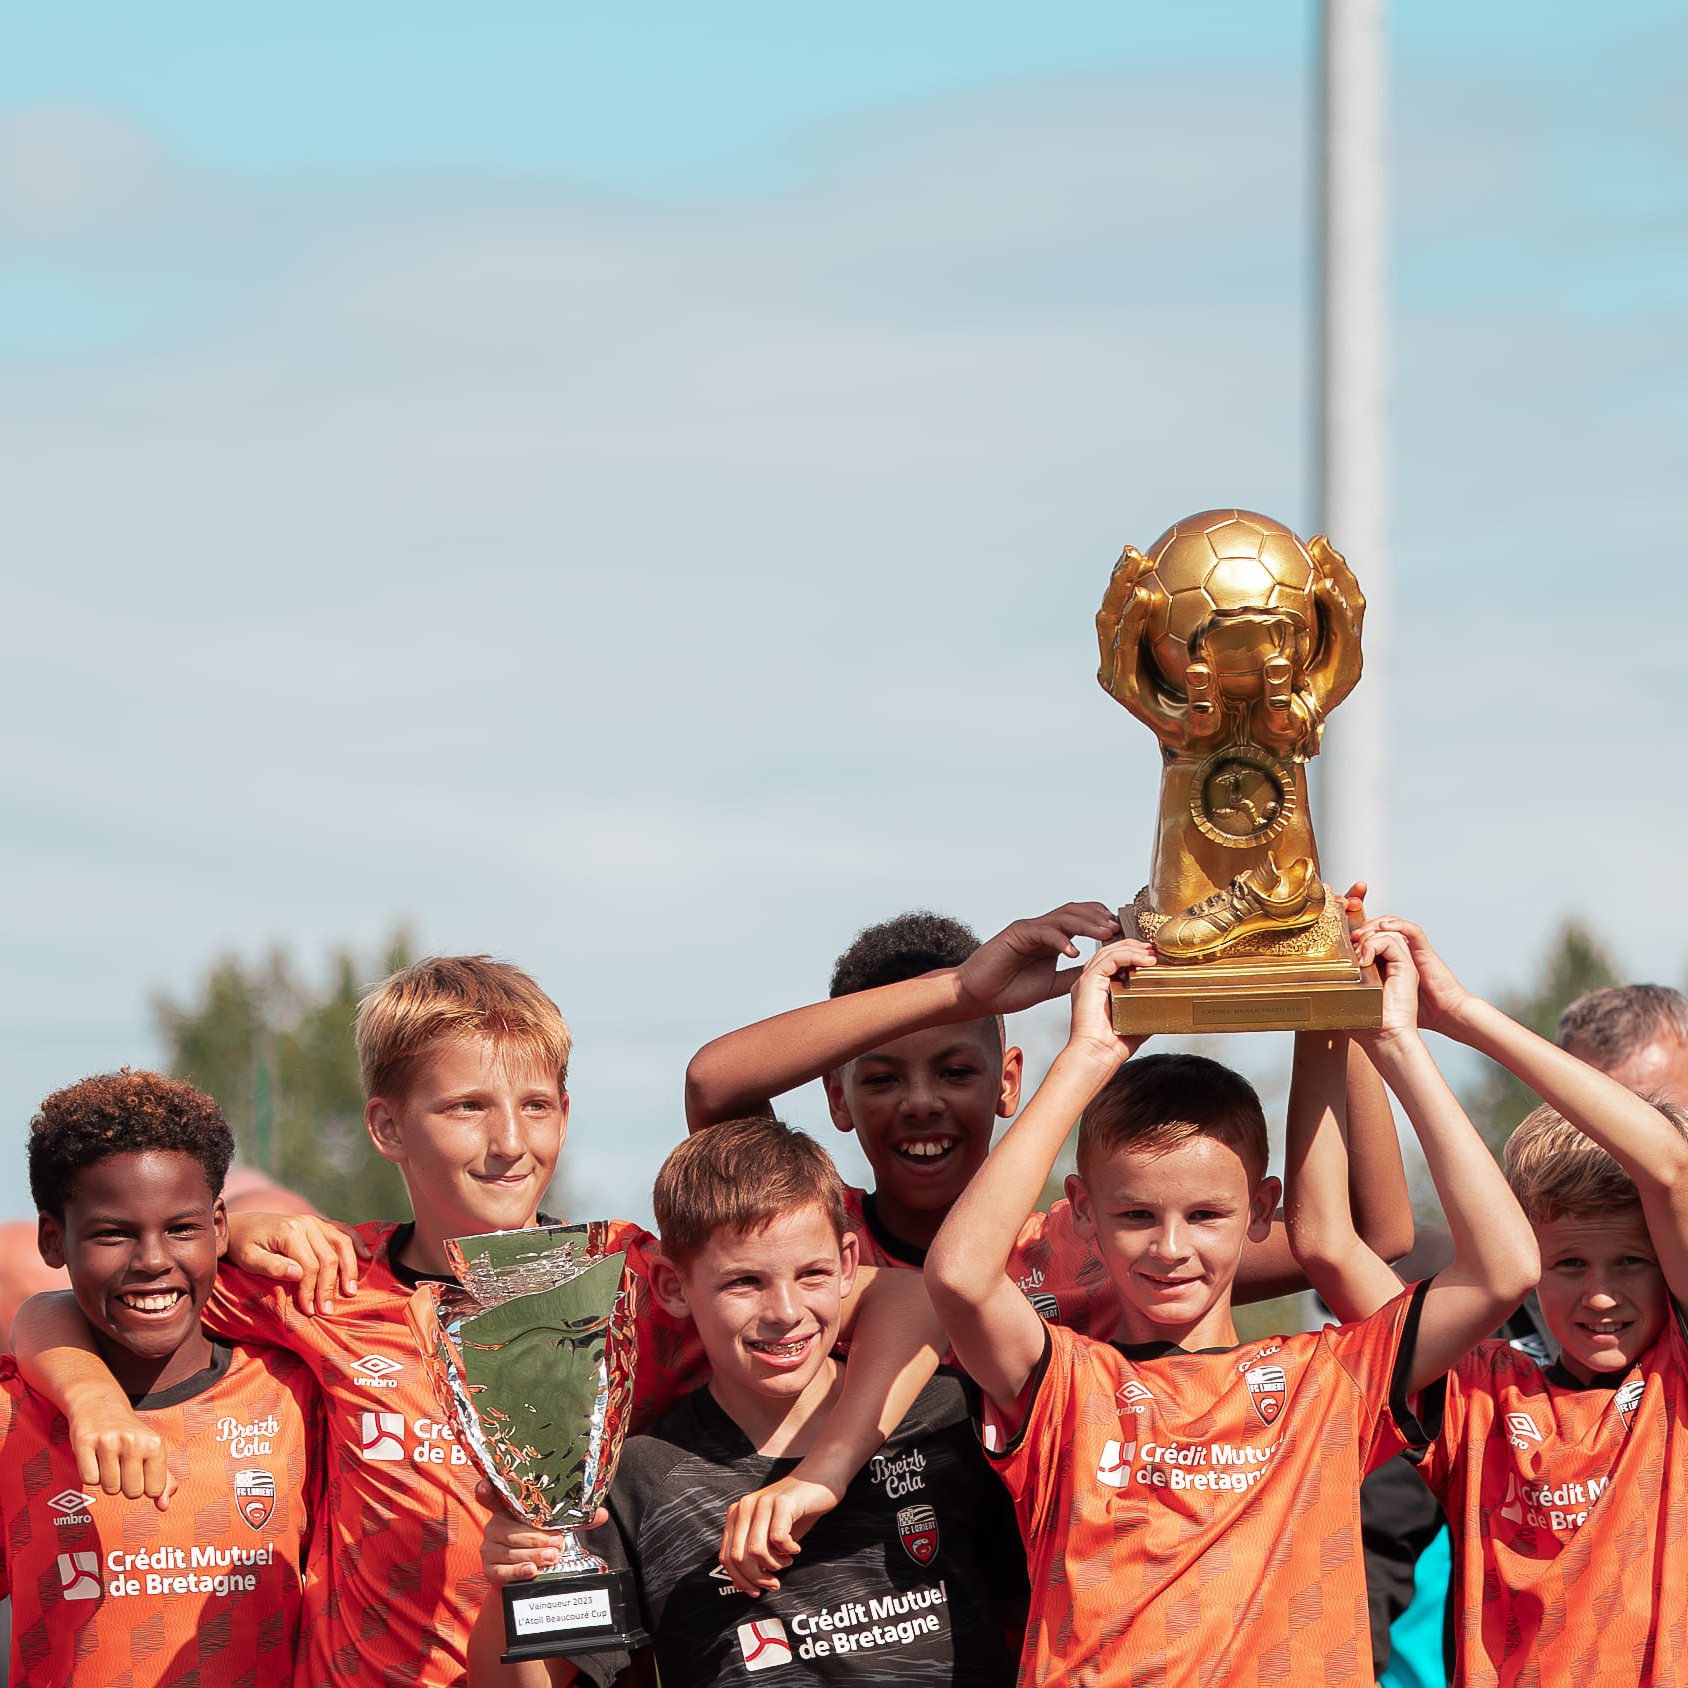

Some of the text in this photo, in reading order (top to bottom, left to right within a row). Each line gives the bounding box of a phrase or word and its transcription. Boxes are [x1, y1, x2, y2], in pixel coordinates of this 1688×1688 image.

[354, 1377, 398, 1388] umbro
[216, 1415, 280, 1442] Breizh
[230, 1437, 272, 1458] Cola
[413, 1441, 444, 1464] de
[1140, 1443, 1207, 1465] Crédit
[870, 1448, 926, 1484] Breizh
[1136, 1465, 1169, 1487] de
[886, 1473, 925, 1498] Cola
[1522, 1483, 1585, 1508] Crédit
[53, 1513, 92, 1526] umbro
[1526, 1509, 1547, 1529] de
[107, 1542, 274, 1572] Crédit Mutuel
[109, 1572, 256, 1597] de Bretagne
[528, 1597, 593, 1611] Vainqueur 2023
[792, 1579, 948, 1636] Crédit Mutuel
[546, 1611, 589, 1623] Beaucouzé
[591, 1609, 607, 1619] Cup
[799, 1613, 940, 1660] de Bretagne
